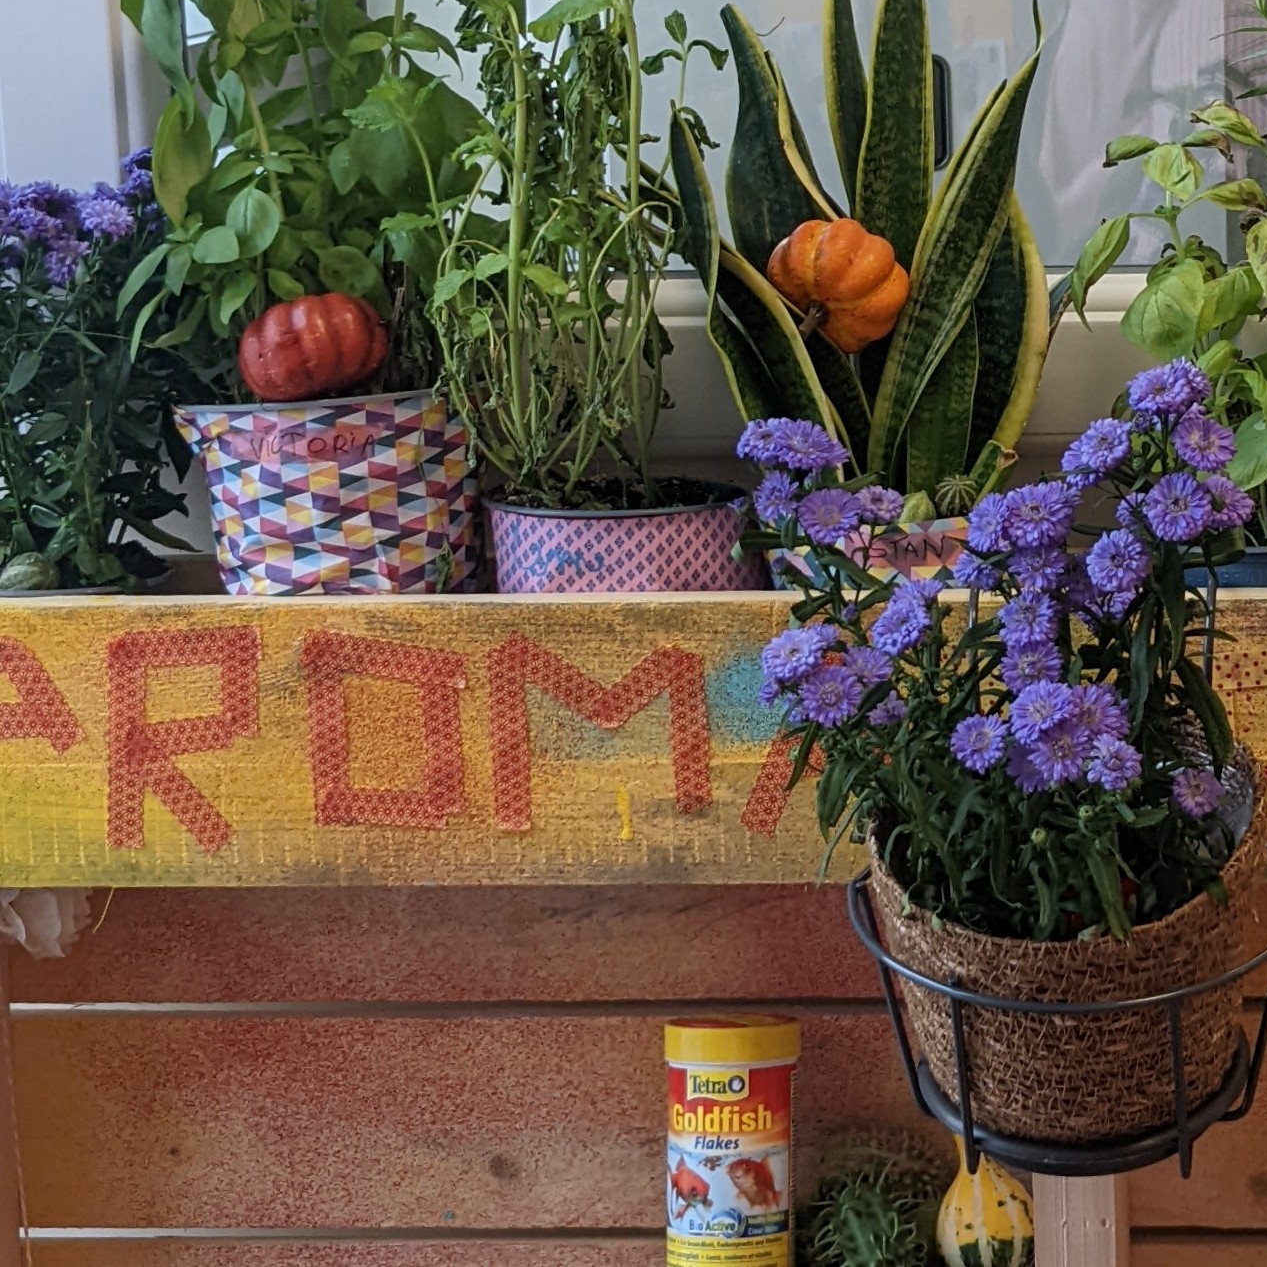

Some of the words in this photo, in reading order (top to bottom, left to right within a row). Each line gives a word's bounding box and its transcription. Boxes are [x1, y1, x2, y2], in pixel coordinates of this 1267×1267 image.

[690, 1074, 728, 1095] Tetra
[673, 1103, 773, 1133] Goldfish
[694, 1136, 740, 1151] Flakes
